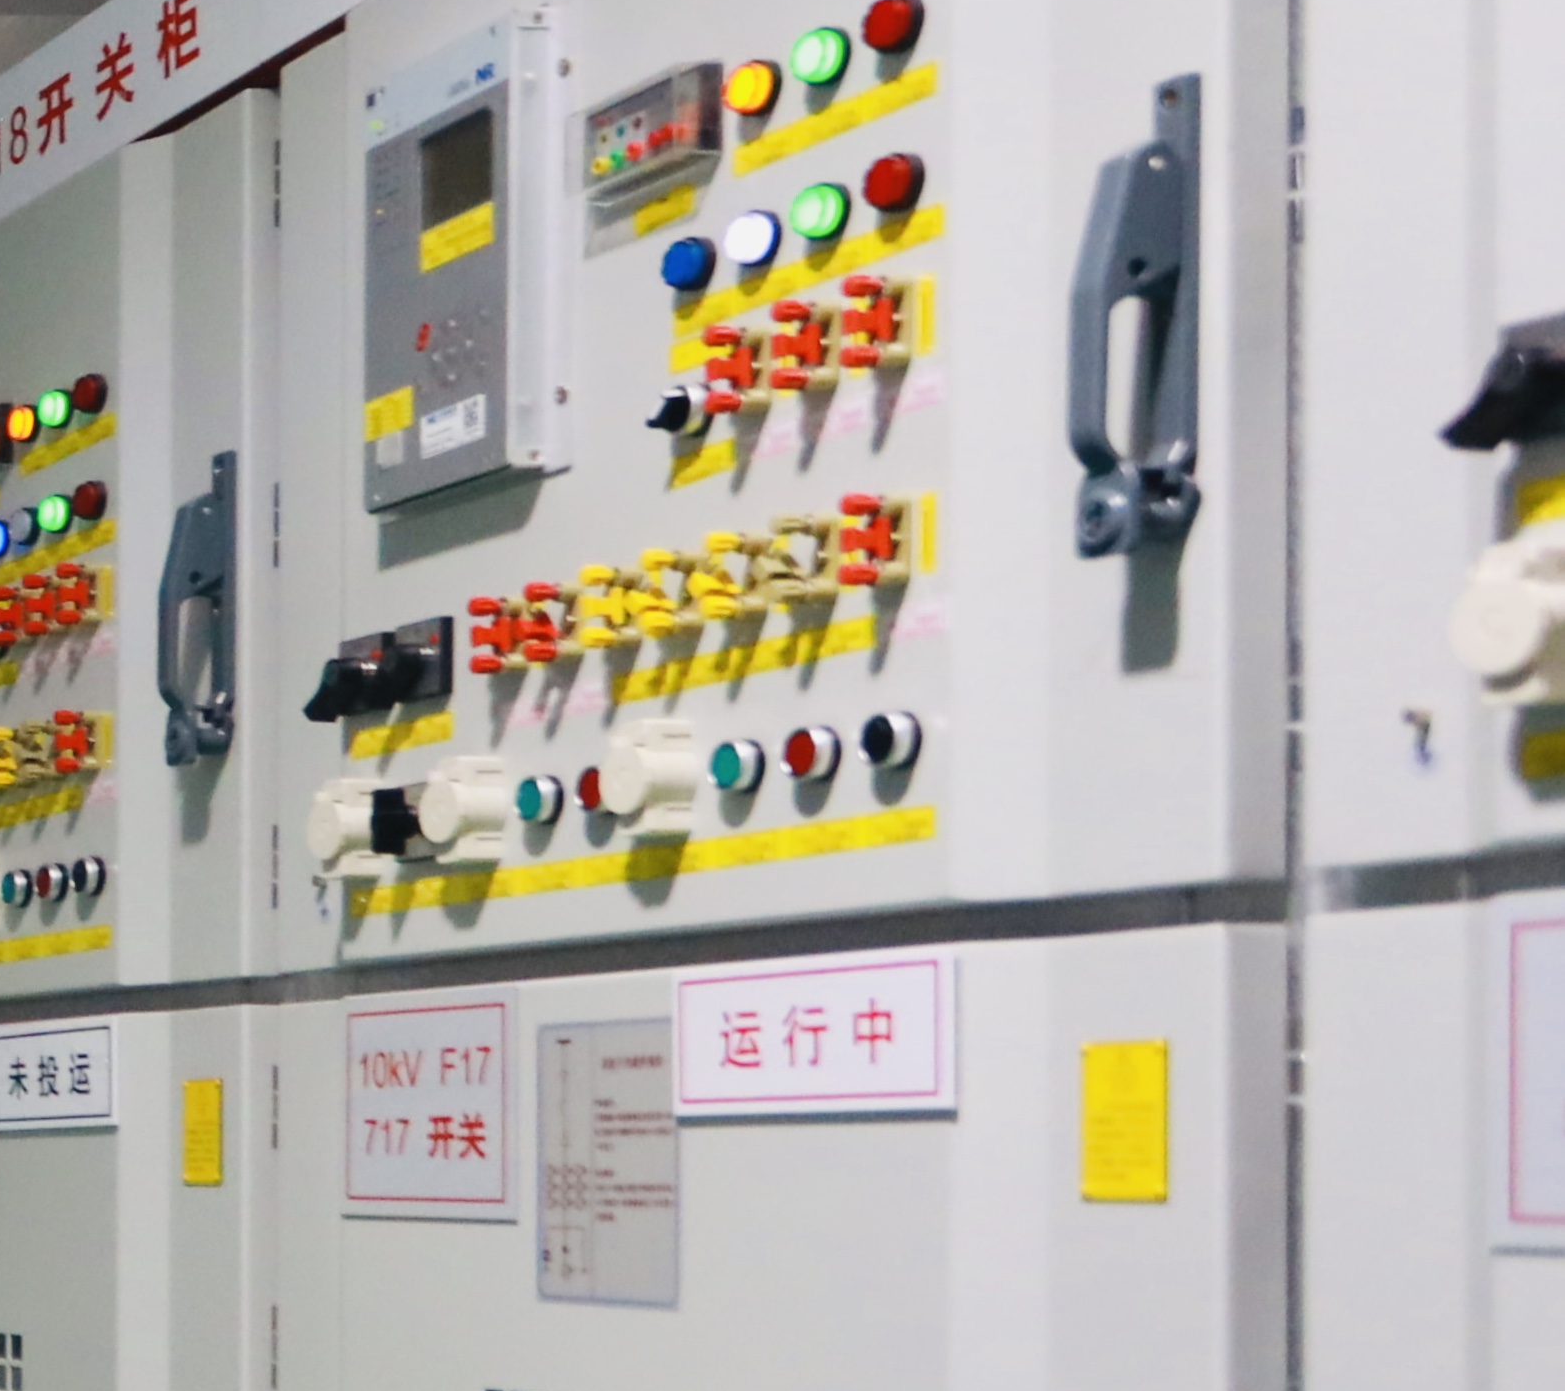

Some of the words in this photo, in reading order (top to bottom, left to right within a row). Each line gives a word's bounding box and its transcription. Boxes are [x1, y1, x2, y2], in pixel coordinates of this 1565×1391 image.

[719, 998, 895, 1069] 运行中
[8, 1053, 91, 1100] 未投运
[359, 1049, 422, 1088] 10kV
[440, 1045, 492, 1085] F17
[363, 1119, 410, 1156] 717
[427, 1113, 487, 1160] 开关
